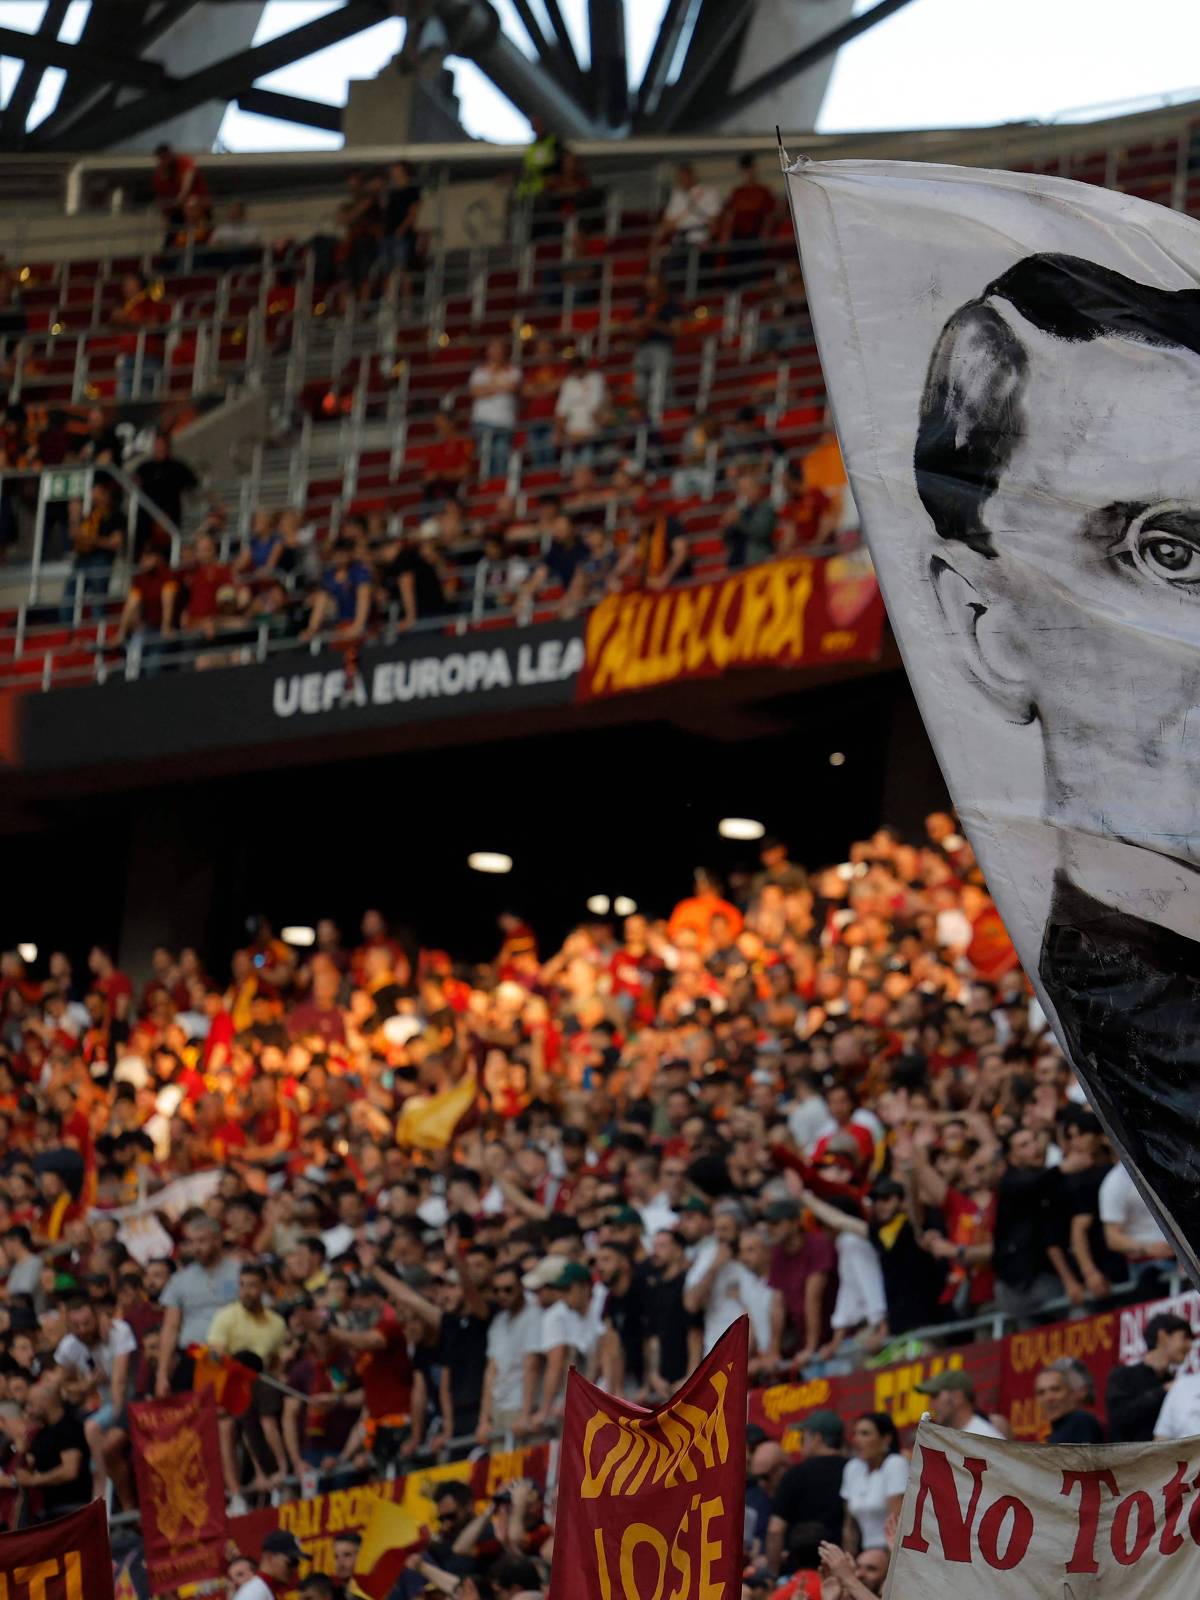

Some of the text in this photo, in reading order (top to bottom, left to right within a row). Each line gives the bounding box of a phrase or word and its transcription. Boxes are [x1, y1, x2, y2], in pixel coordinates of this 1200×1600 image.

[272, 638, 585, 717] UEFA EUROPA LEA
[901, 1445, 1035, 1571] No
